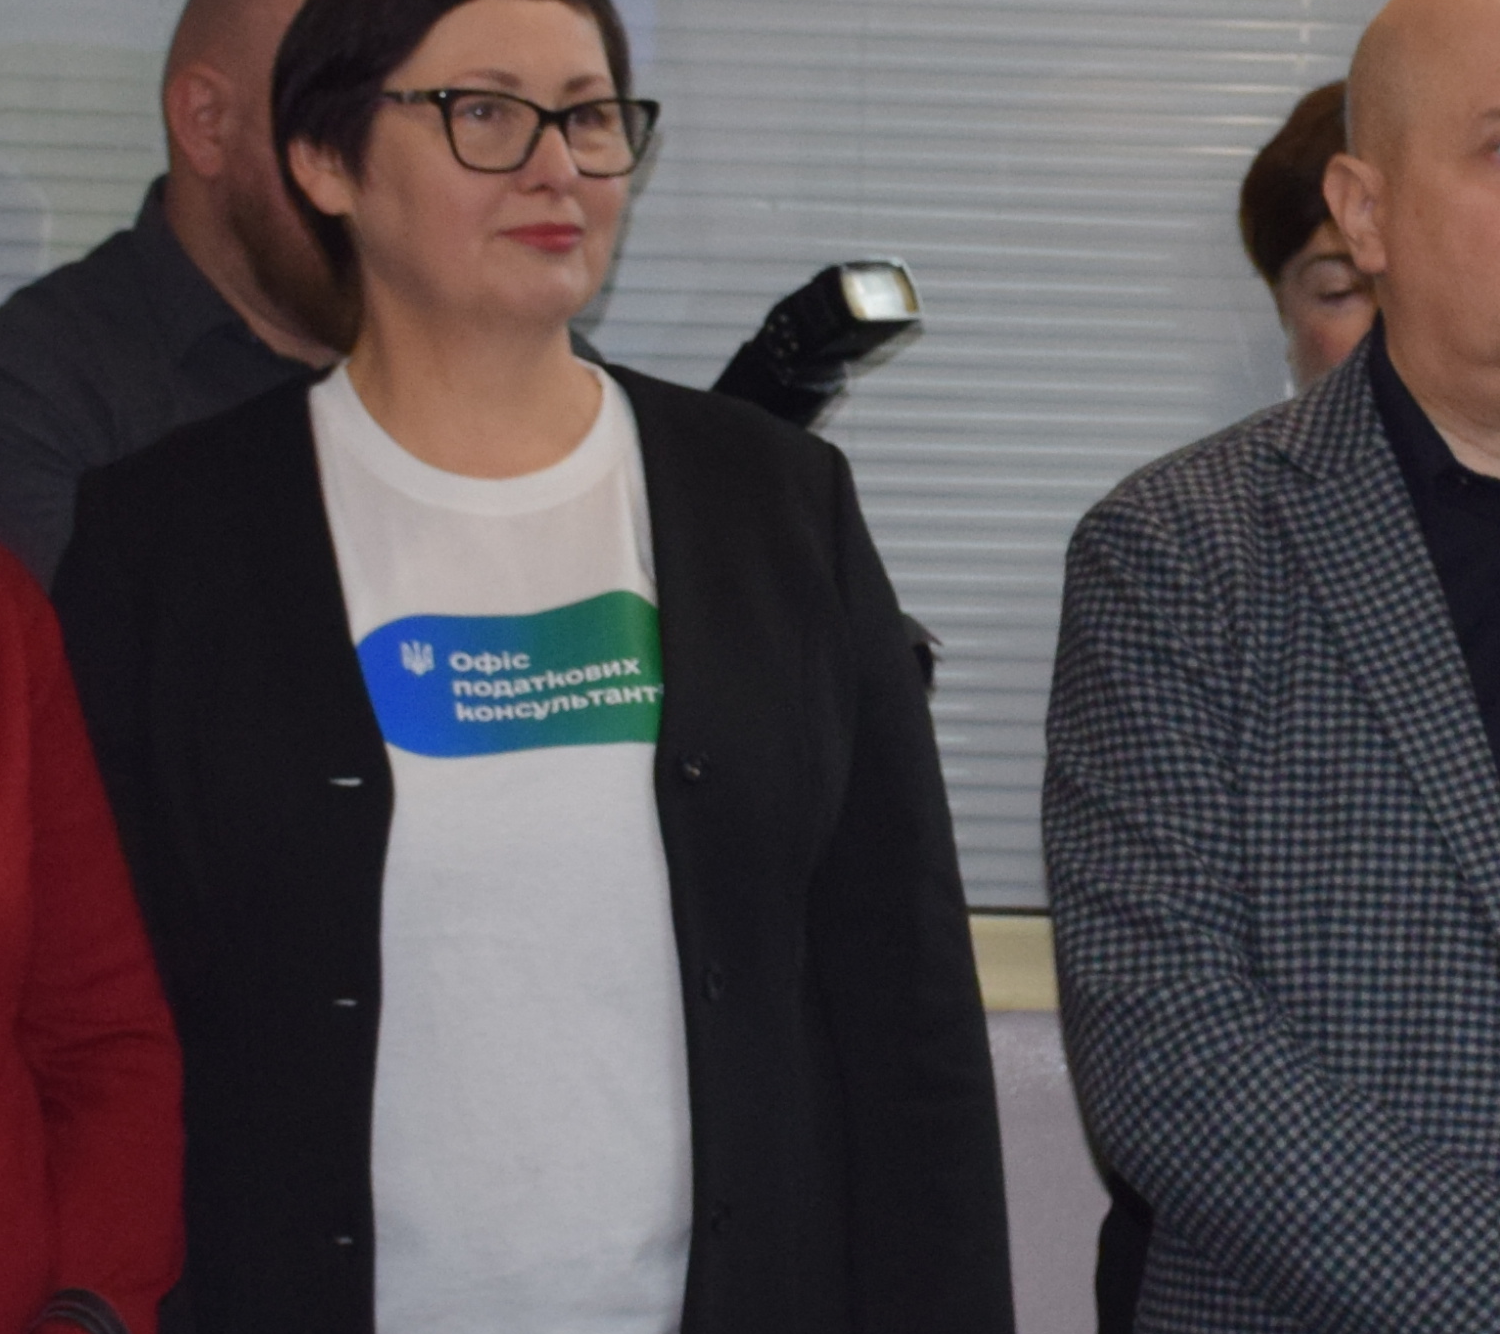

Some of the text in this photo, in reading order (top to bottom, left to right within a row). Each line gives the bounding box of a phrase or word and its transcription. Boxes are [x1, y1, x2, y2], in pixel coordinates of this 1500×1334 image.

[451, 652, 530, 673] Офіс
[454, 658, 640, 698] податкових
[457, 684, 663, 721] консультант
